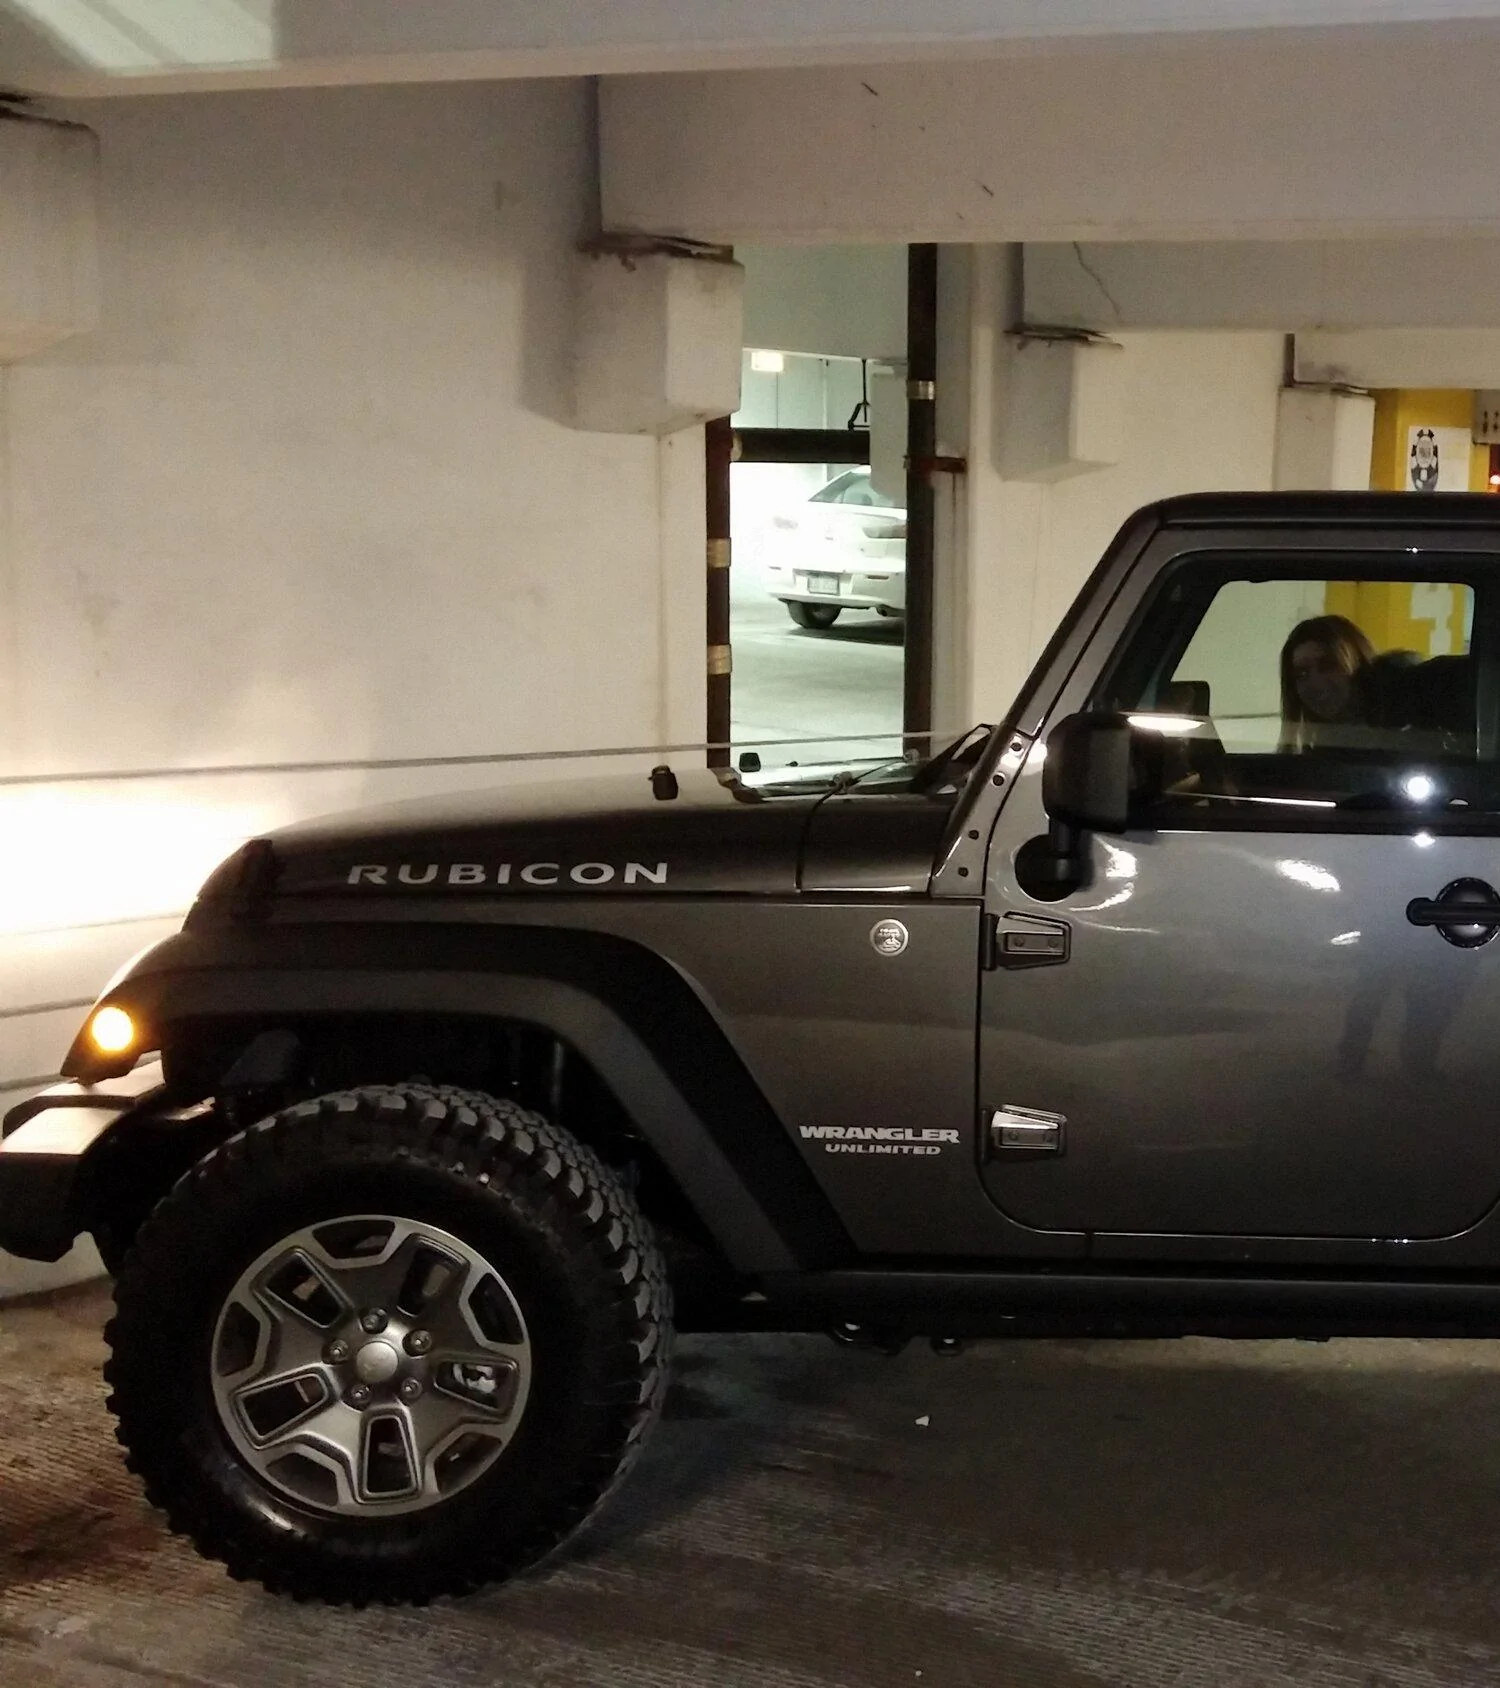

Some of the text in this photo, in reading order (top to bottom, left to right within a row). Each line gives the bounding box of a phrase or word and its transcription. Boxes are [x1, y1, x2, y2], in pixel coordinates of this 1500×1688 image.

[346, 862, 669, 886] RUBICON
[799, 1125, 961, 1143] WRANGLER
[825, 1143, 942, 1155] UNLIMITED
